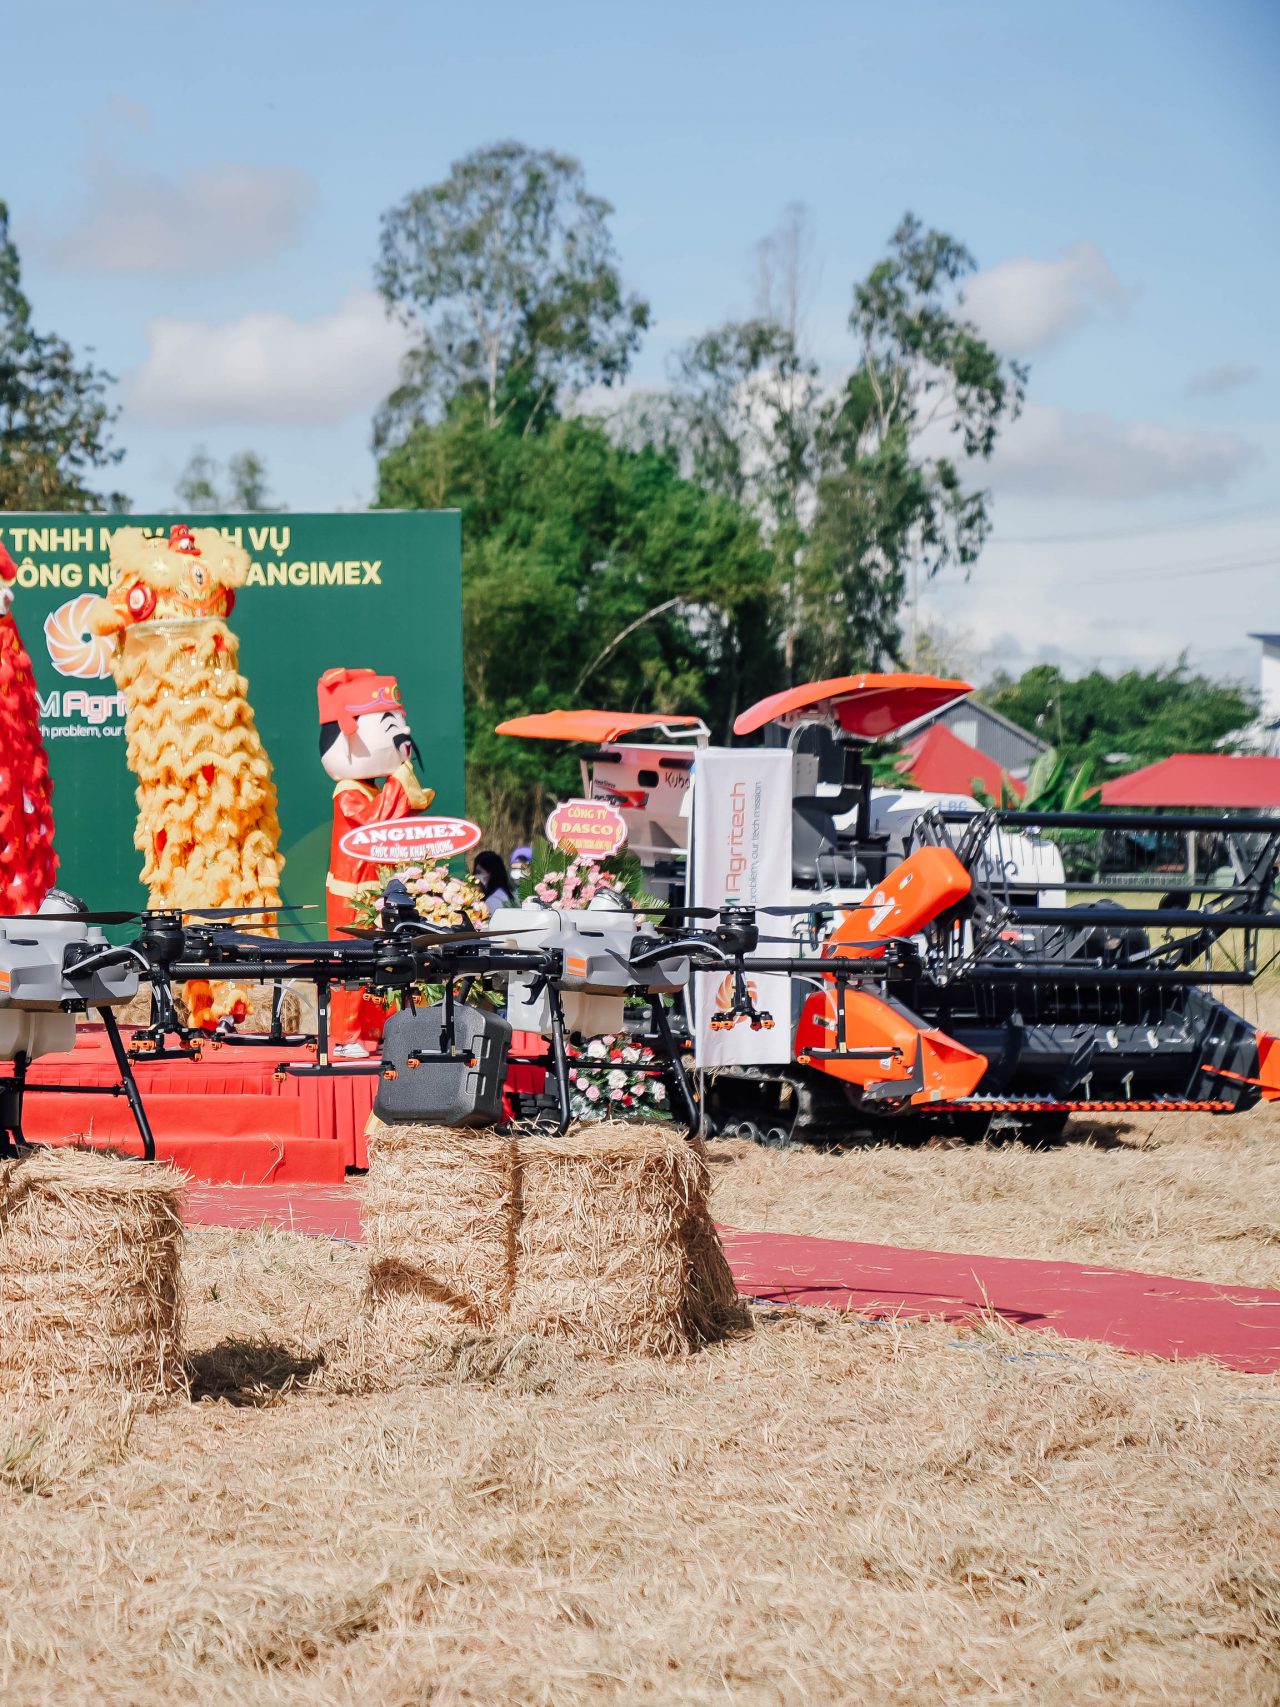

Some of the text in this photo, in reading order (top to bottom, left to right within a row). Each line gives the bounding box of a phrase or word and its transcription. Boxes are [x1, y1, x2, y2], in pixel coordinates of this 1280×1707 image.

[9, 527, 94, 552] TNHH
[248, 526, 291, 557] VỤ
[9, 556, 83, 588] ÔNG
[246, 560, 382, 587] ANGIMEX
[351, 823, 467, 845] ANGIMEX
[561, 822, 613, 835] DASCO
